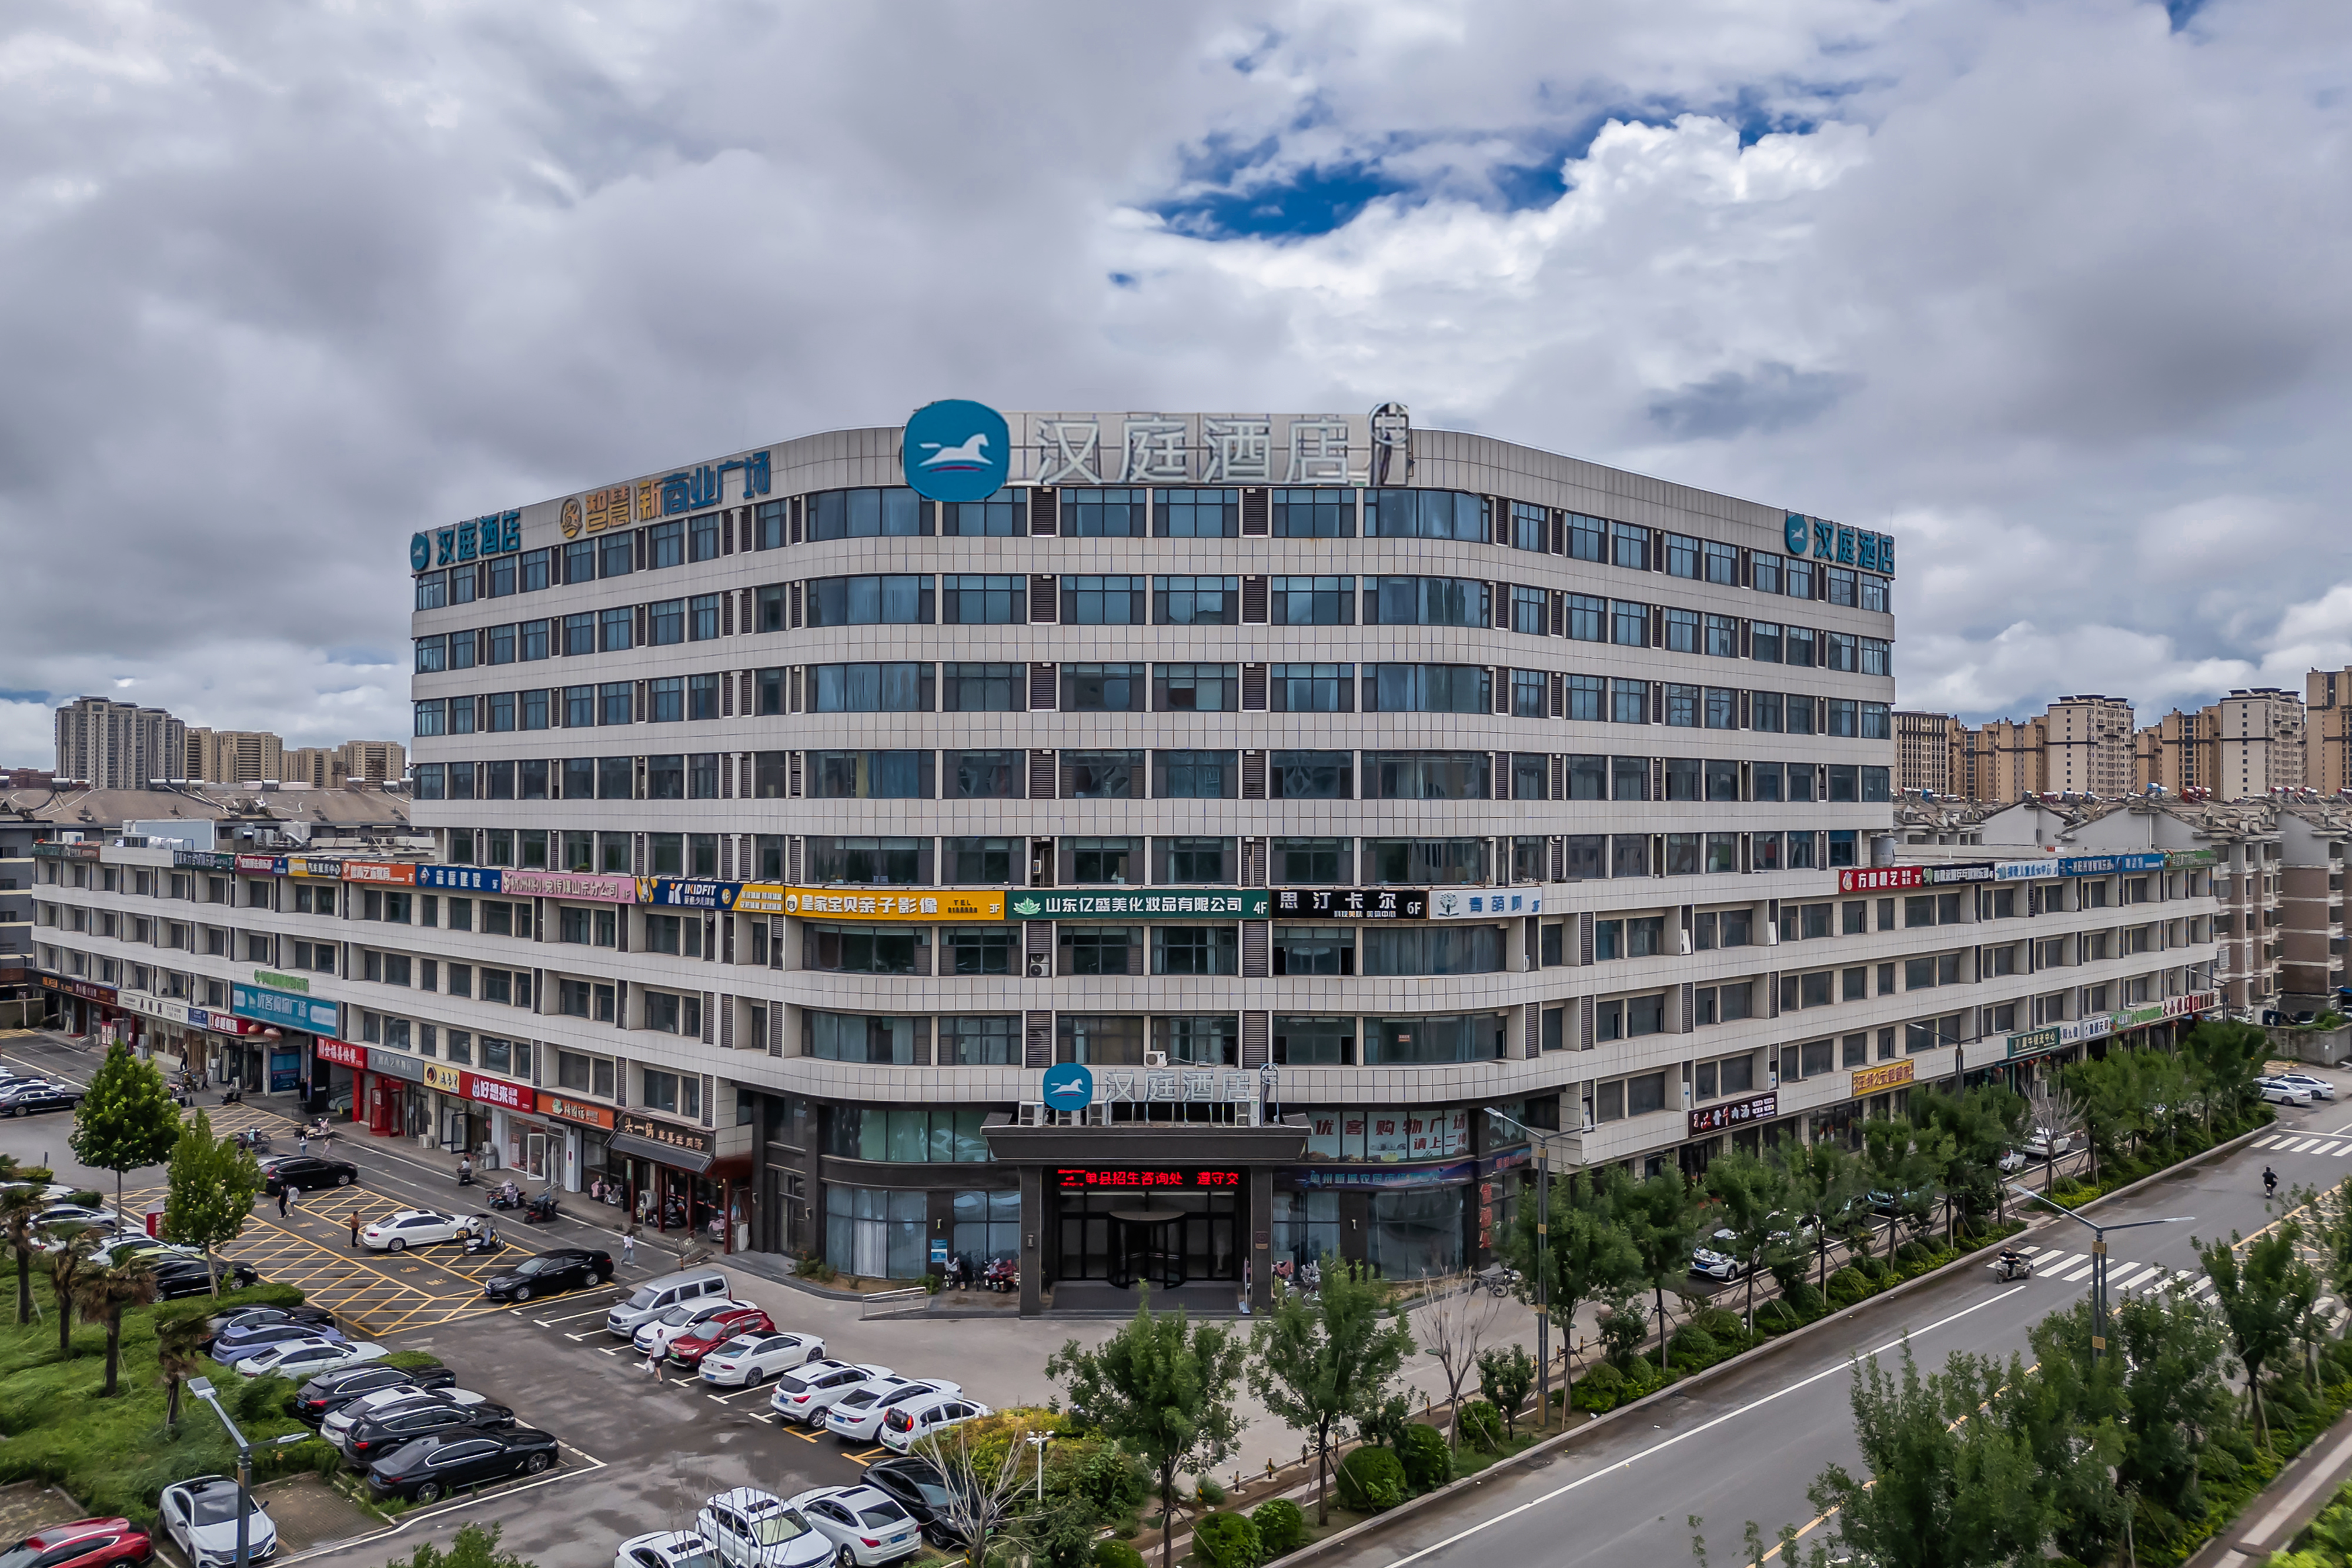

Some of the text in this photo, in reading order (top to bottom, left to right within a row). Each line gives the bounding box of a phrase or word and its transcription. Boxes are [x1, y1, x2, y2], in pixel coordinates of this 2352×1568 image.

[1035, 416, 1351, 485] 汉庭酒店
[437, 512, 521, 566] 汉庭酒店
[1814, 519, 1894, 574] 汉庭酒店
[801, 894, 938, 914] 皇家宝贝亲子影像
[989, 903, 1000, 914] 3F
[1045, 897, 1268, 914] 山东亿盛美化妆品有限公司 4F
[1280, 891, 1422, 915] 思汀卡尔 6F
[480, 1080, 509, 1104] 好想来
[1104, 1071, 1251, 1103] 汉庭酒店
[624, 1117, 655, 1139] 头一锅
[1315, 1114, 1466, 1135] 优客购物广场
[1414, 1132, 1467, 1151] 请上二楼
[1085, 1171, 1183, 1185] 单县招生咨询处
[1197, 1171, 1239, 1185] 遵守交
